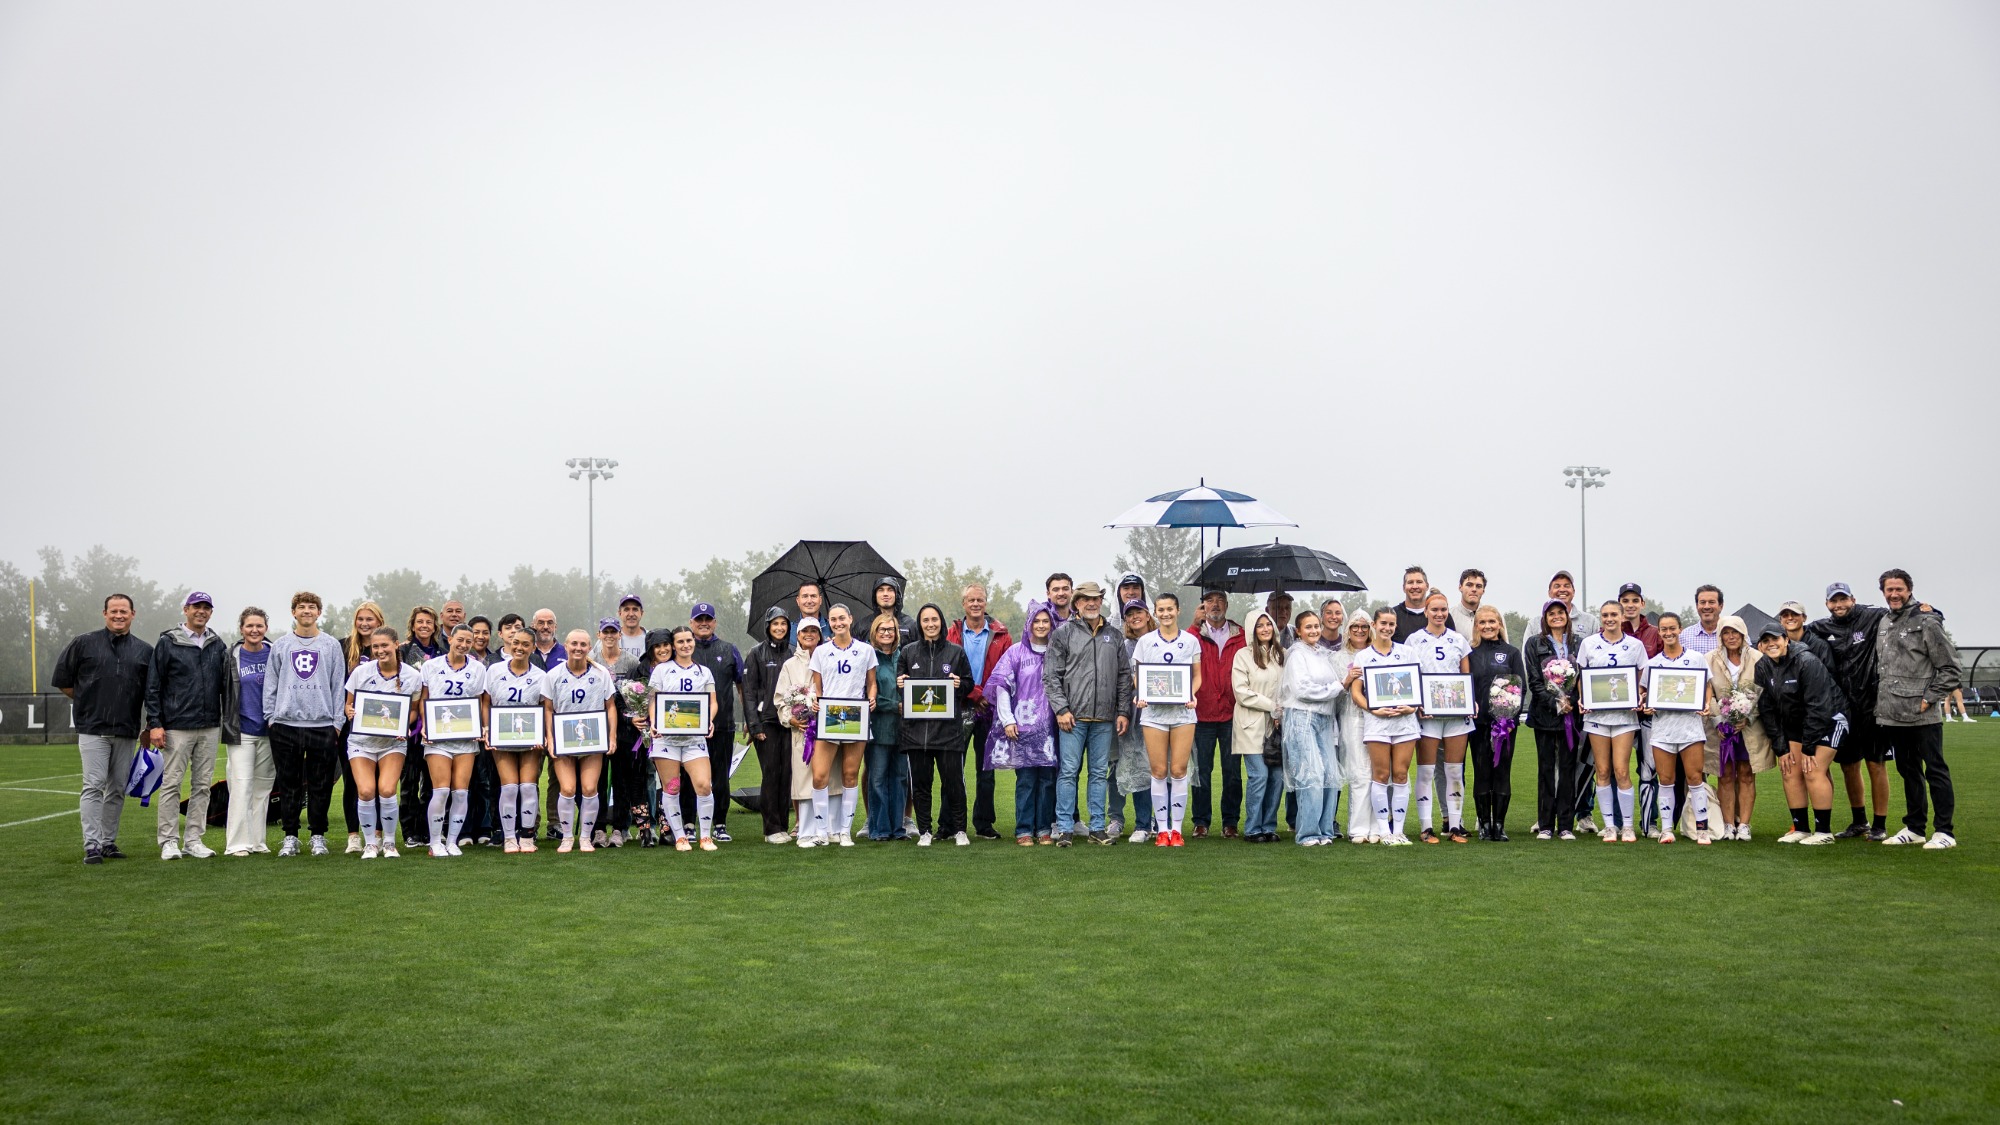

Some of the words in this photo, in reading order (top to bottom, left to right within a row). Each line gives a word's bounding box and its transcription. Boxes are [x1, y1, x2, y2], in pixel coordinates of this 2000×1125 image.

[1163, 652, 1174, 664] 9
[1435, 646, 1446, 661] 5
[1608, 653, 1618, 667] 3
[240, 664, 257, 678] HOLY
[257, 663, 266, 673] CR
[837, 660, 852, 674] 16
[444, 680, 464, 696] 23
[680, 678, 693, 692] 18
[507, 687, 523, 703] 21
[571, 688, 586, 704] 19
